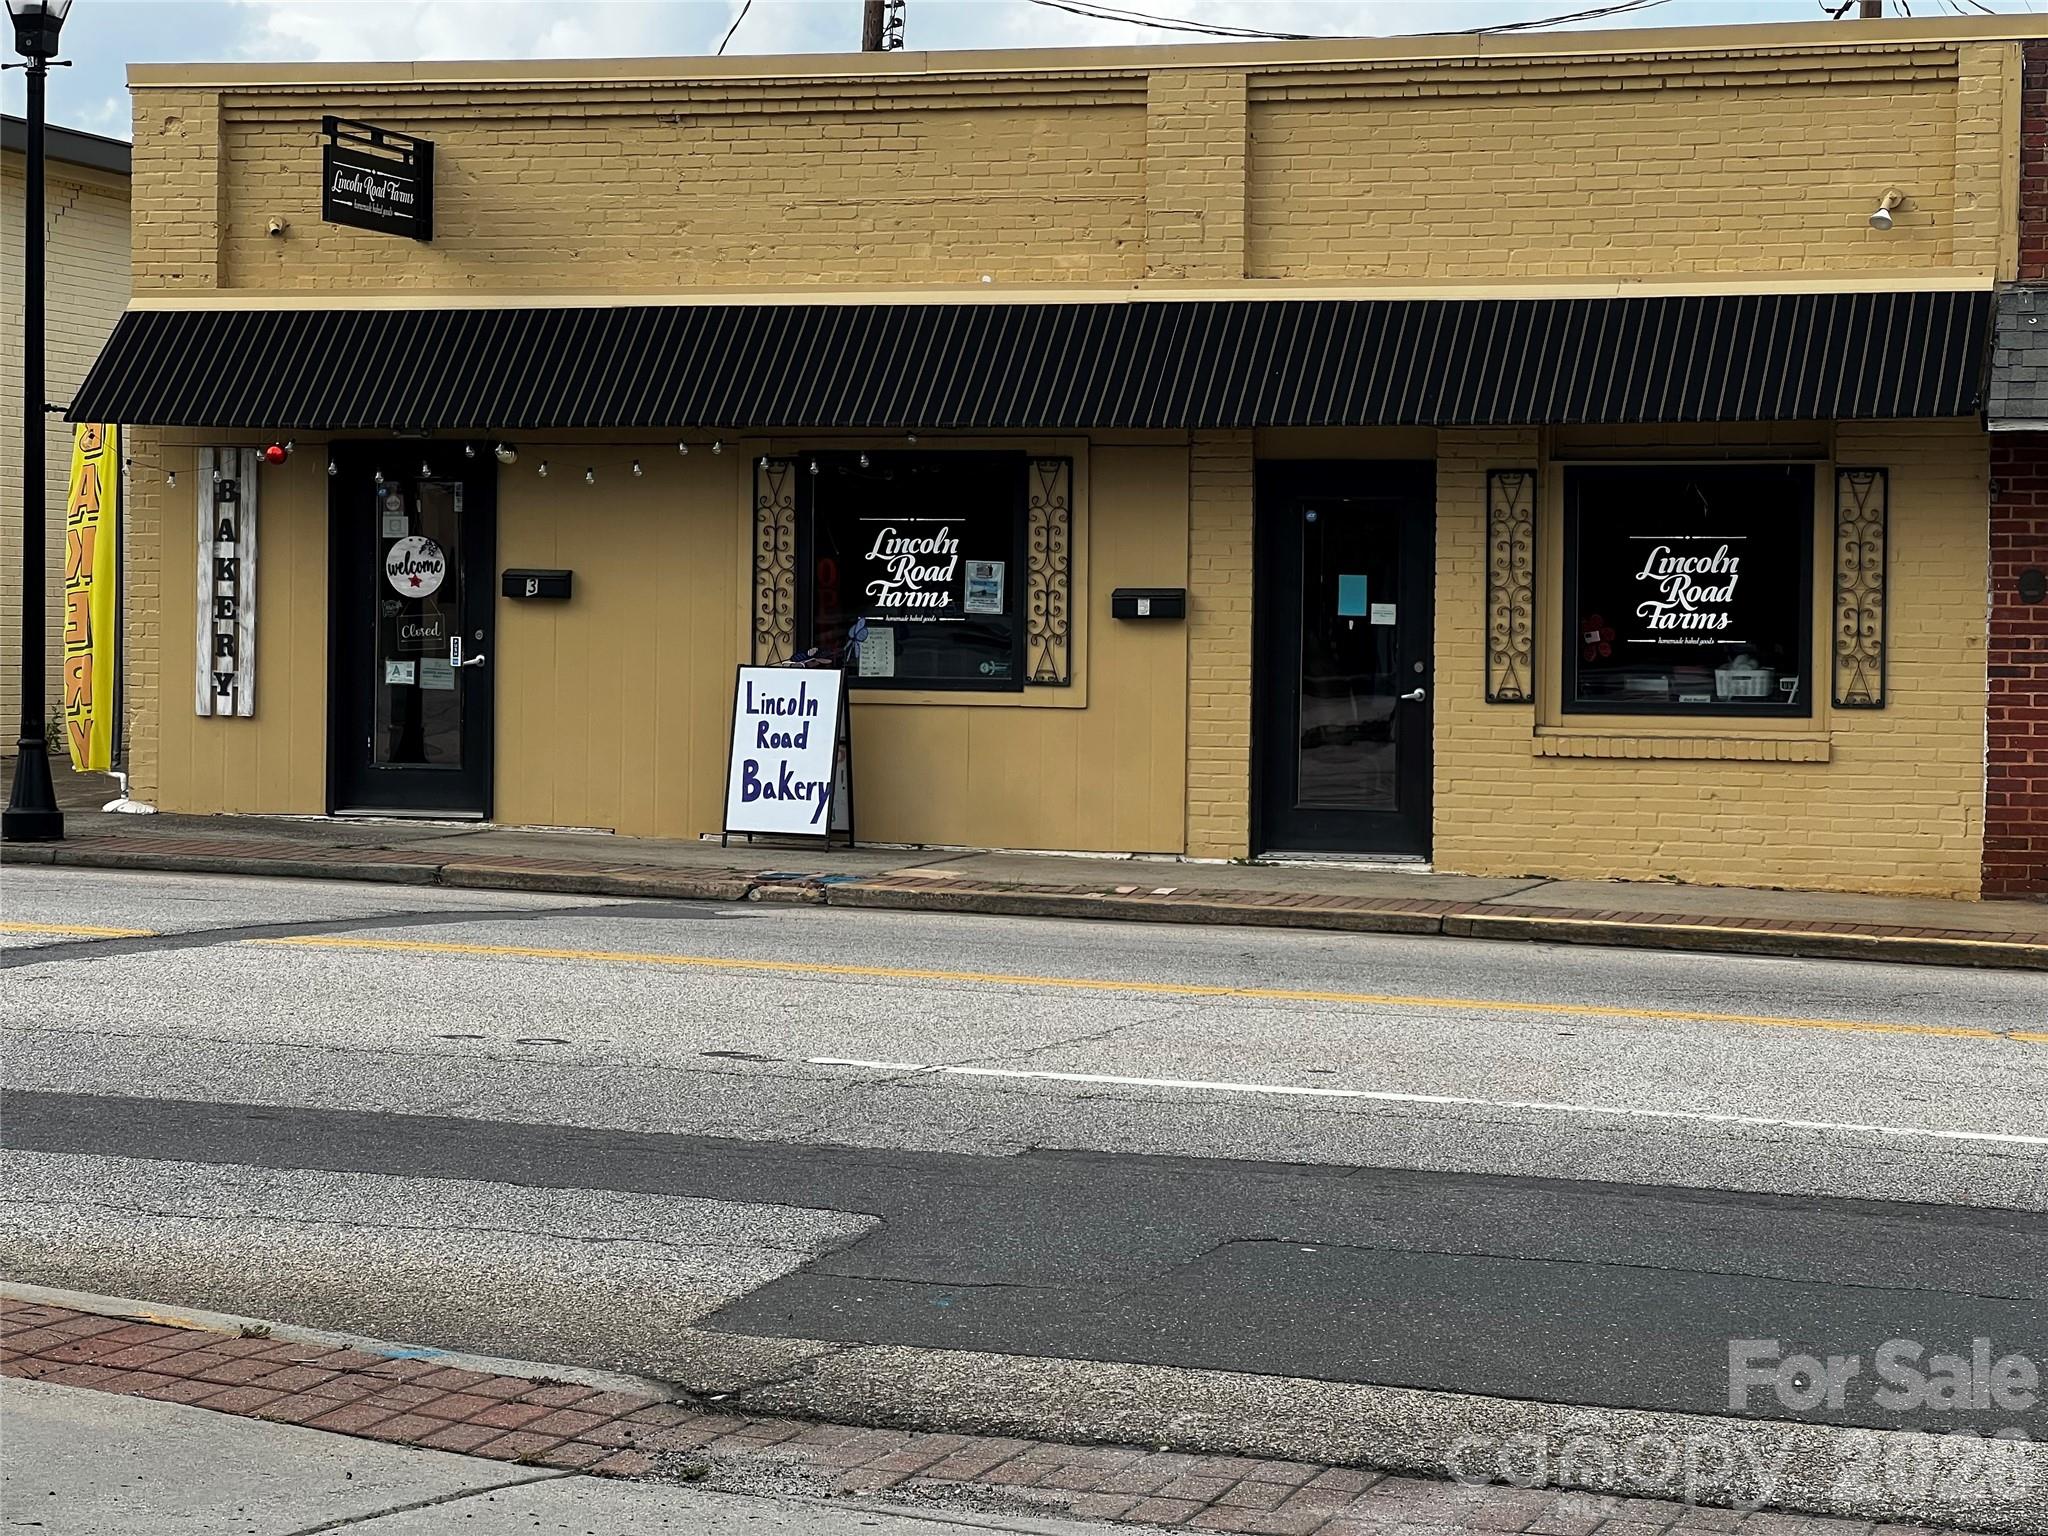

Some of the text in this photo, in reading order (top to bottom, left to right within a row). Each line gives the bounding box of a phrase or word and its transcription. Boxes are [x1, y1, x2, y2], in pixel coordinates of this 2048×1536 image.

[331, 169, 414, 205] Lincoln Road Farms
[865, 526, 959, 560] Lincoln
[388, 550, 443, 576] welcome
[887, 554, 958, 590] Road
[1635, 544, 1740, 580] Lincoln
[214, 479, 237, 697] BAKERY
[528, 579, 537, 593] 3
[865, 580, 952, 607] Farms
[1660, 574, 1739, 611] Road
[401, 621, 442, 638] Closed
[1636, 599, 1733, 629] Farms
[391, 664, 401, 676] A
[746, 681, 819, 717] Lincoln
[756, 720, 810, 750] Road
[741, 758, 831, 825] Bakery
